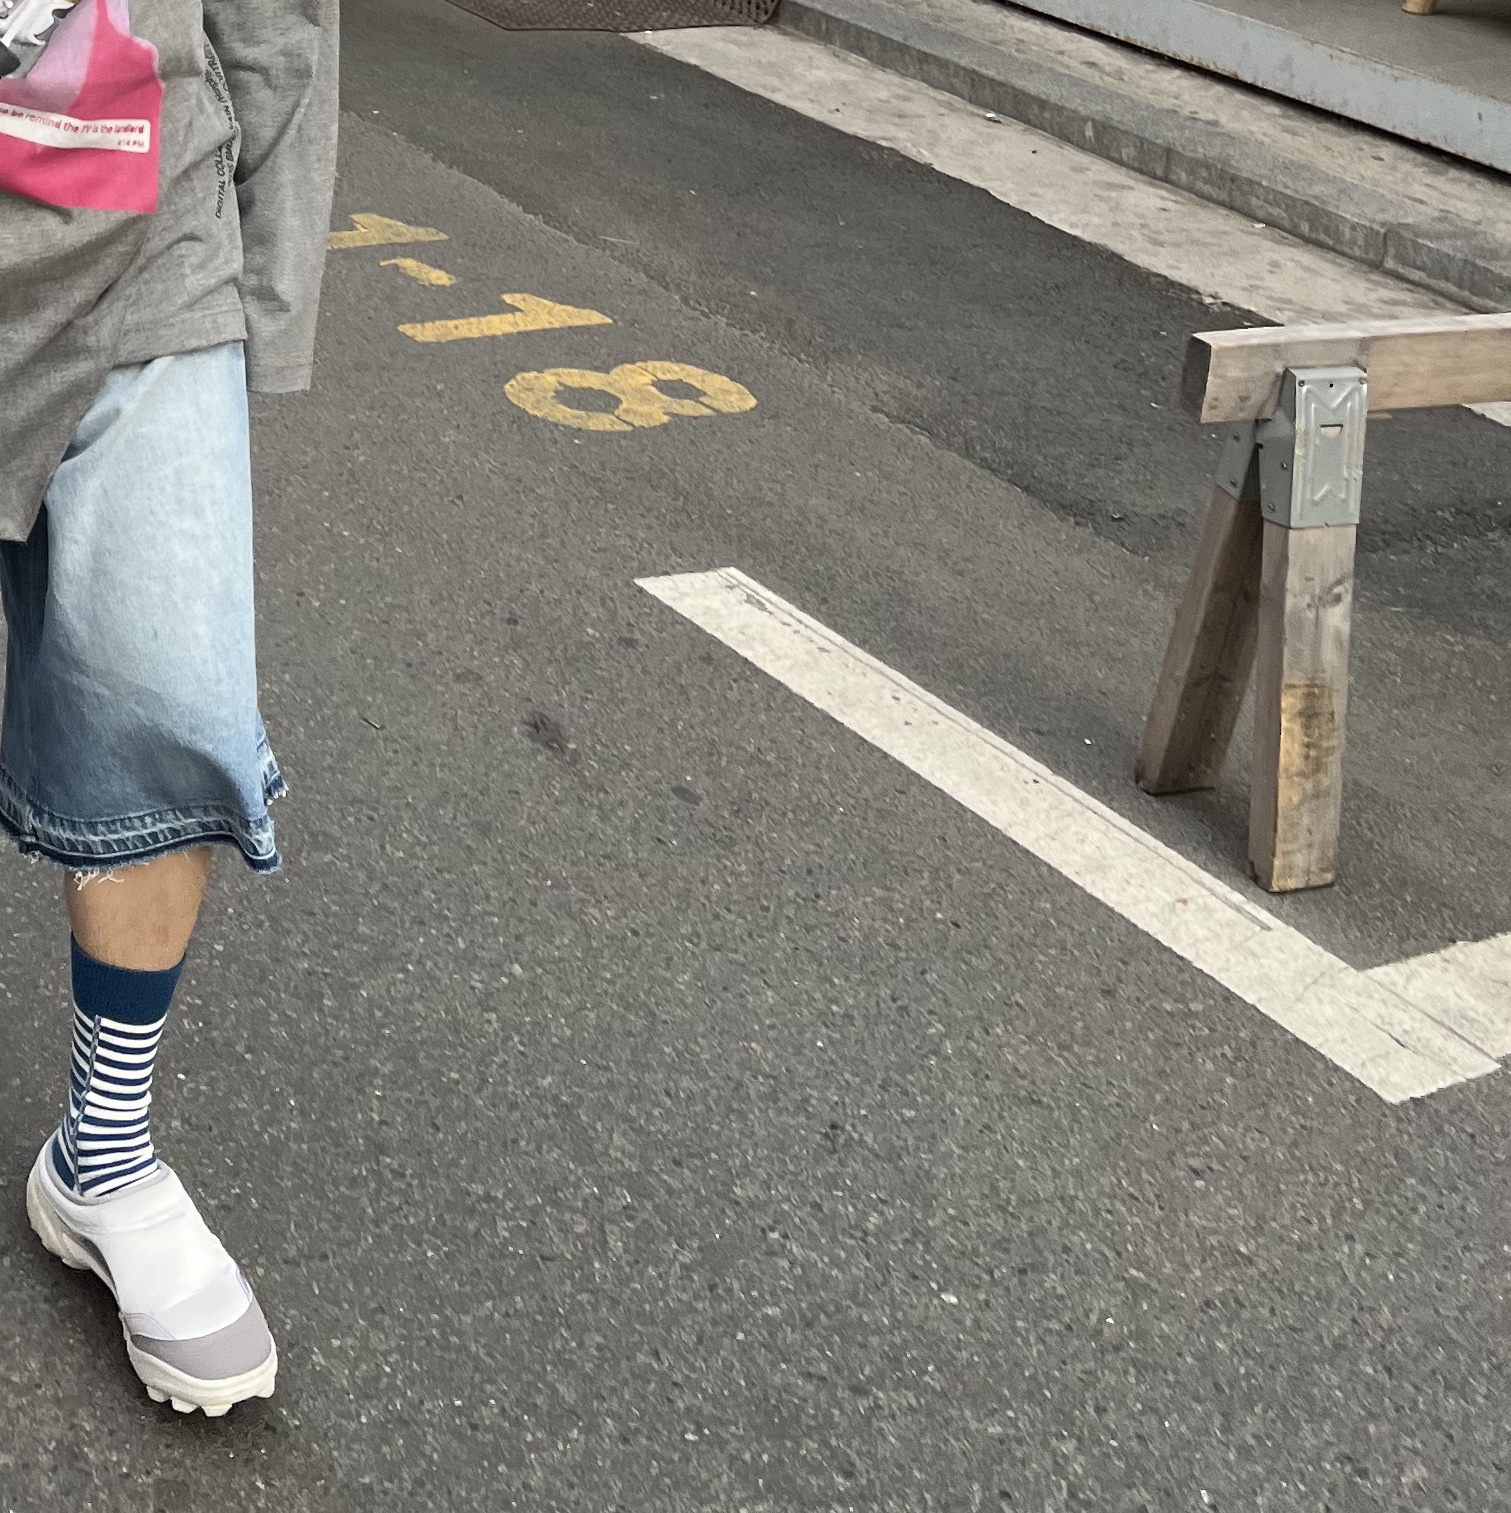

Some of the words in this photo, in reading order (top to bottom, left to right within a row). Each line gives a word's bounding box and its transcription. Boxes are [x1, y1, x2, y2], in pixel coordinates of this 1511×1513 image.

[10, 108, 24, 119] be
[25, 114, 62, 130] remind
[63, 122, 79, 134] the
[99, 124, 113, 134] the
